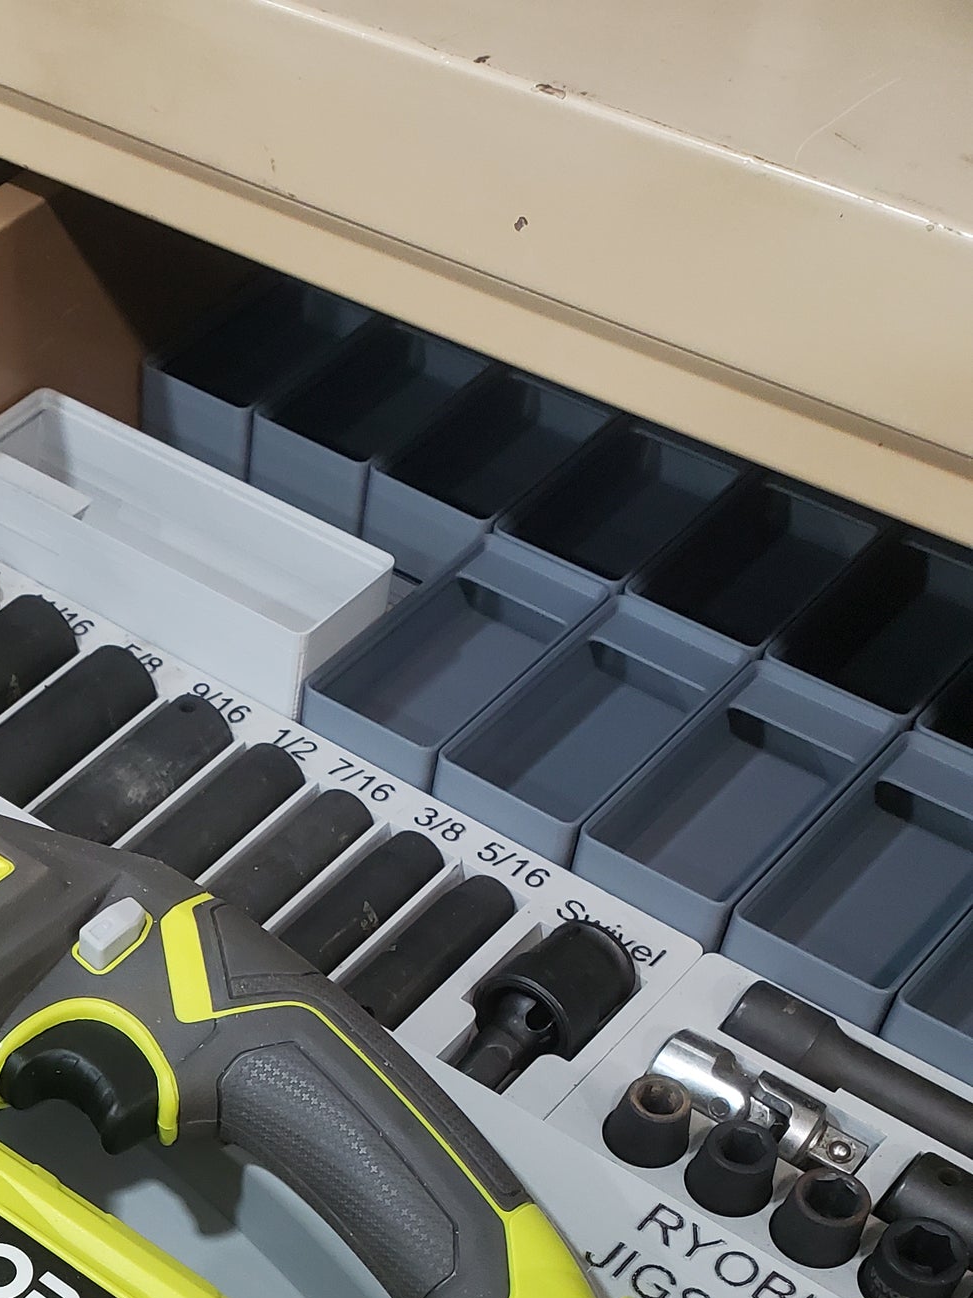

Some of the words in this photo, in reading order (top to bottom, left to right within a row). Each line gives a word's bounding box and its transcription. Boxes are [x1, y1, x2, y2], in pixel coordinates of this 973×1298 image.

[273, 728, 318, 762] 1/2
[328, 758, 396, 802] 7/16
[414, 806, 467, 842] 3/8
[477, 842, 550, 889] 5/16
